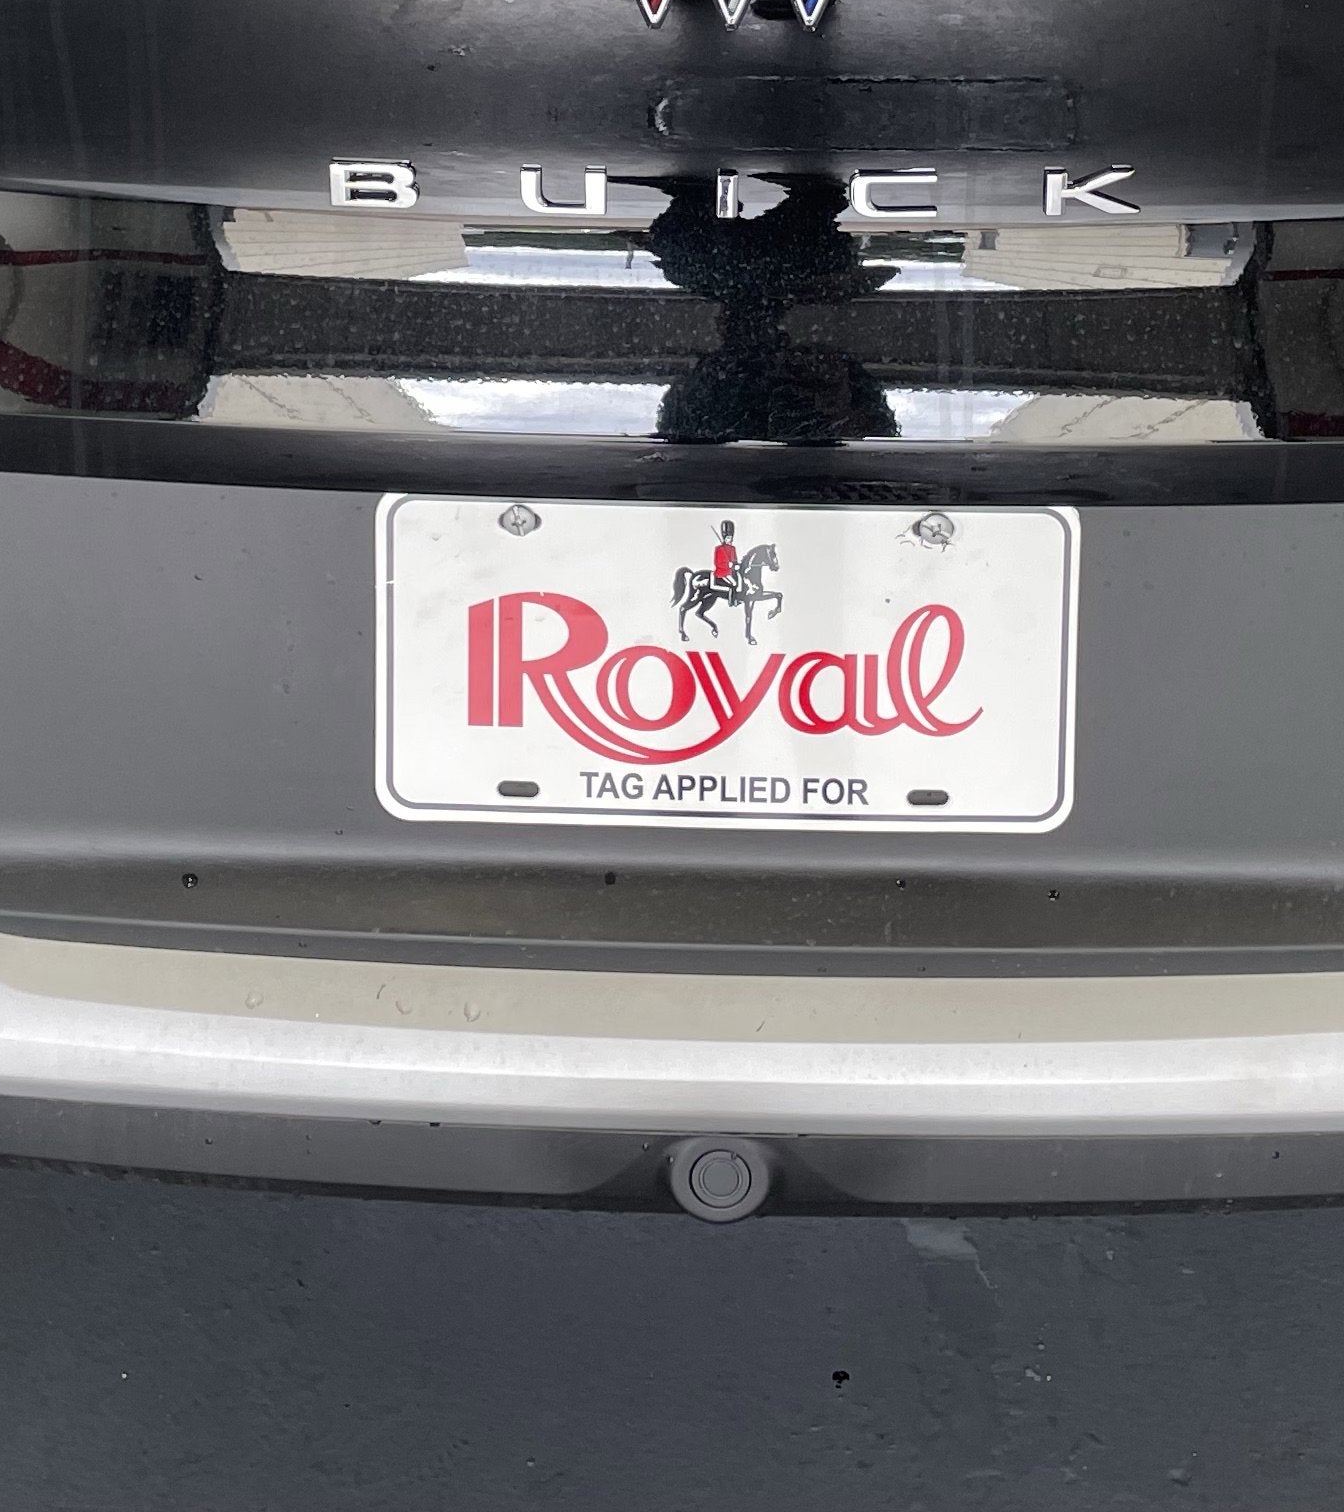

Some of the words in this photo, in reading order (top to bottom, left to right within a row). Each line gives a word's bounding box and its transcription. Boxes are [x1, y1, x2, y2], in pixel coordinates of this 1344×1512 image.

[329, 157, 1143, 219] BUICK
[468, 591, 984, 765] Royal
[579, 771, 645, 800] TAG
[652, 774, 792, 804] APPLIED
[801, 777, 869, 806] FOR
